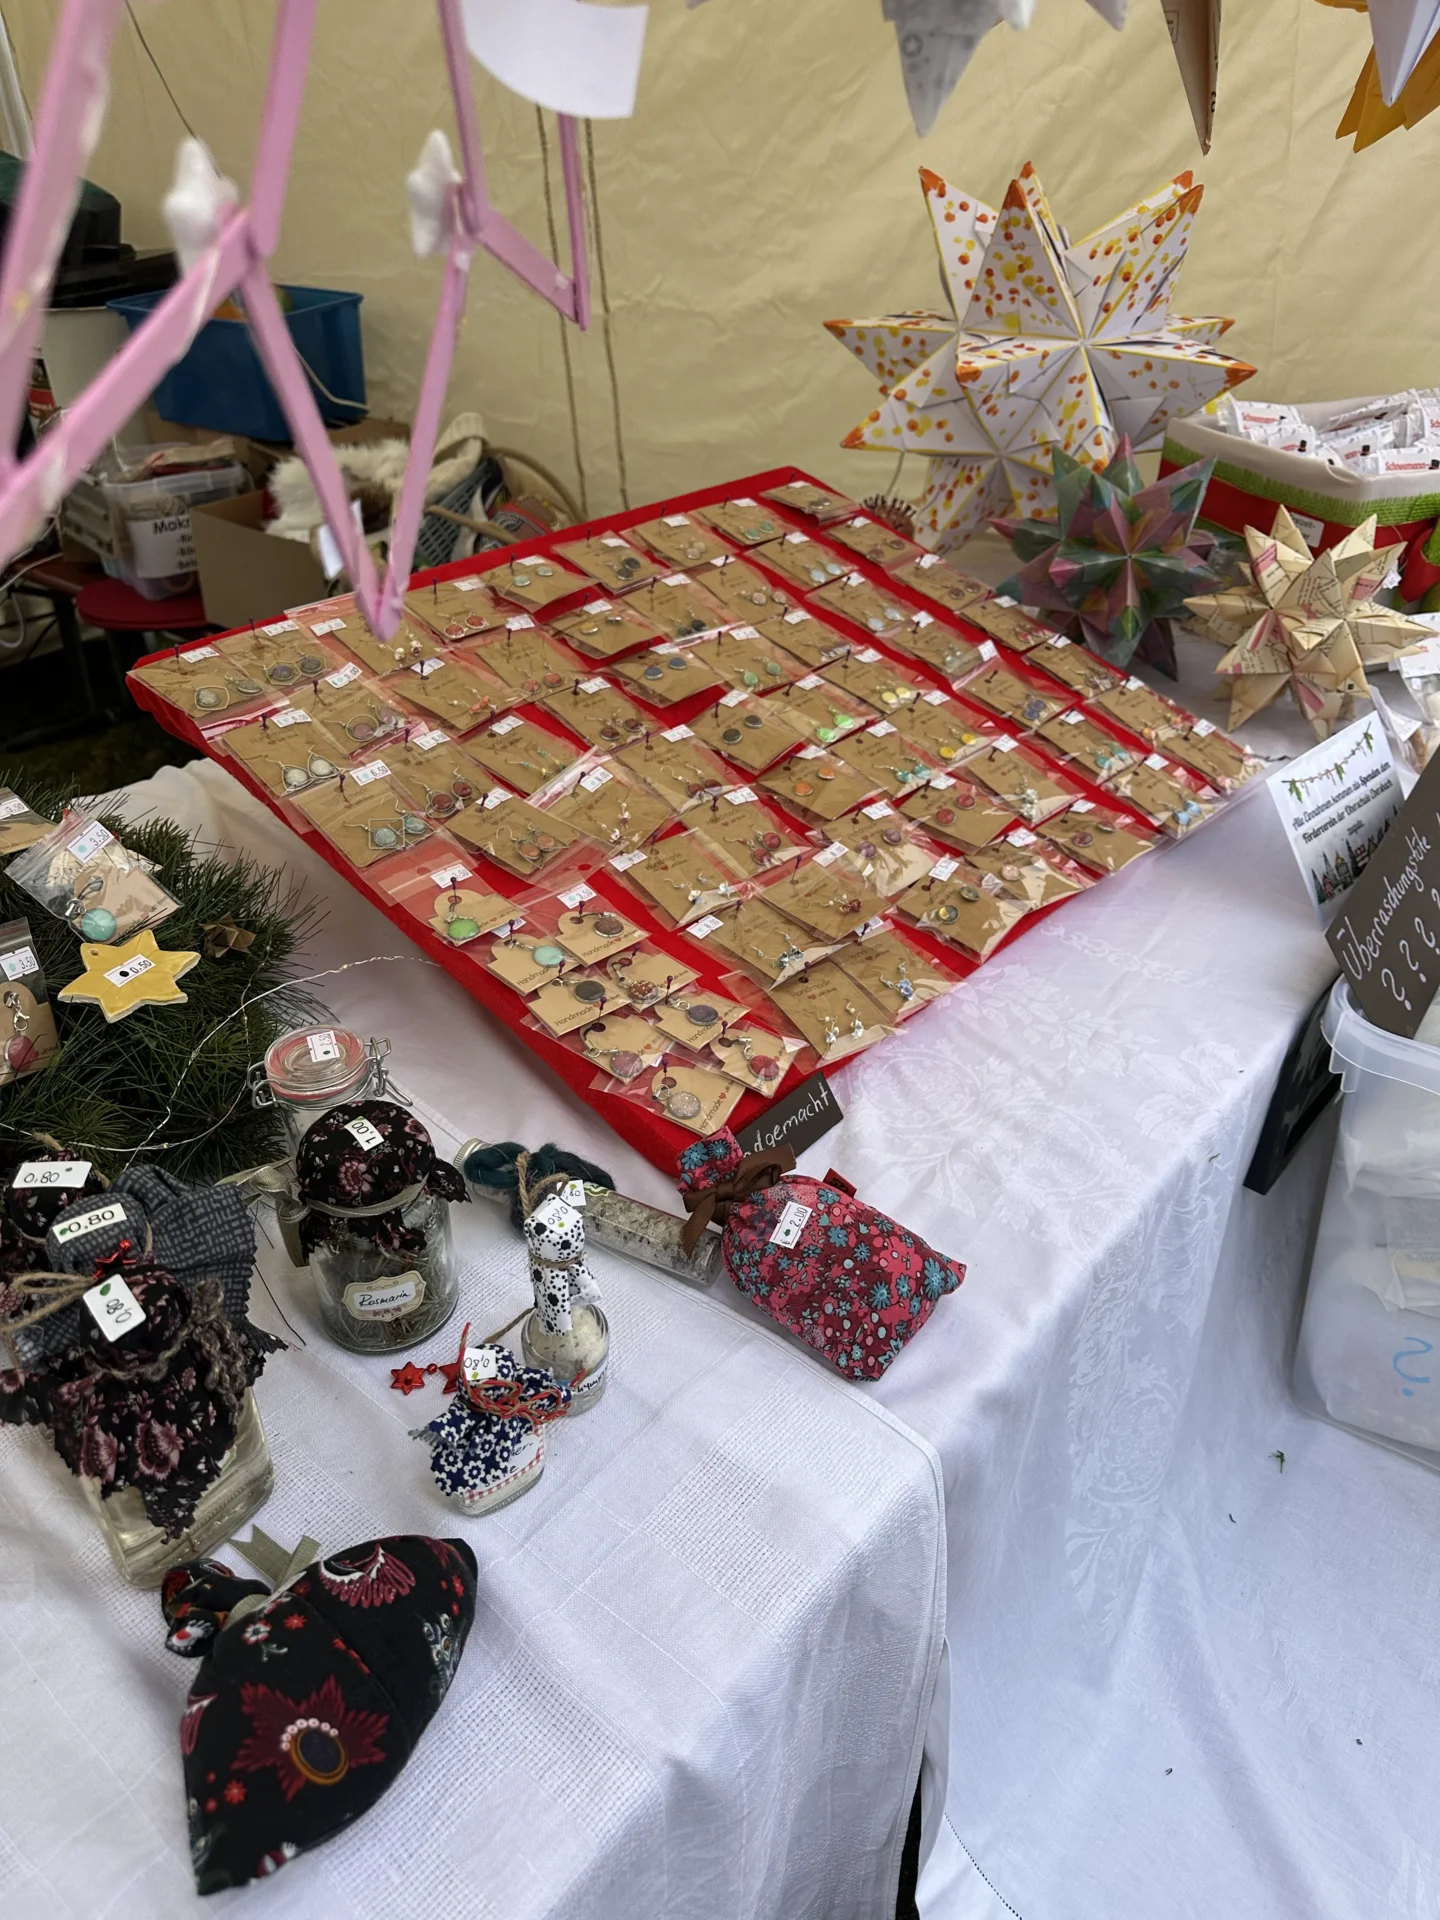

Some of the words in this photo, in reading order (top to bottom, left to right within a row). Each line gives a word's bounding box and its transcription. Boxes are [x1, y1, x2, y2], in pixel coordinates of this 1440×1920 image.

[89, 829, 109, 847] 3.50
[576, 888, 592, 900] 3.50
[20, 956, 36, 970] 3.50
[130, 959, 152, 975] 0.50
[516, 967, 551, 987] Handmad
[554, 1005, 594, 1027] Handmade
[743, 1081, 830, 1158] dgemacht
[789, 1206, 808, 1228] 2.00
[359, 1290, 411, 1307] Rosmarin
